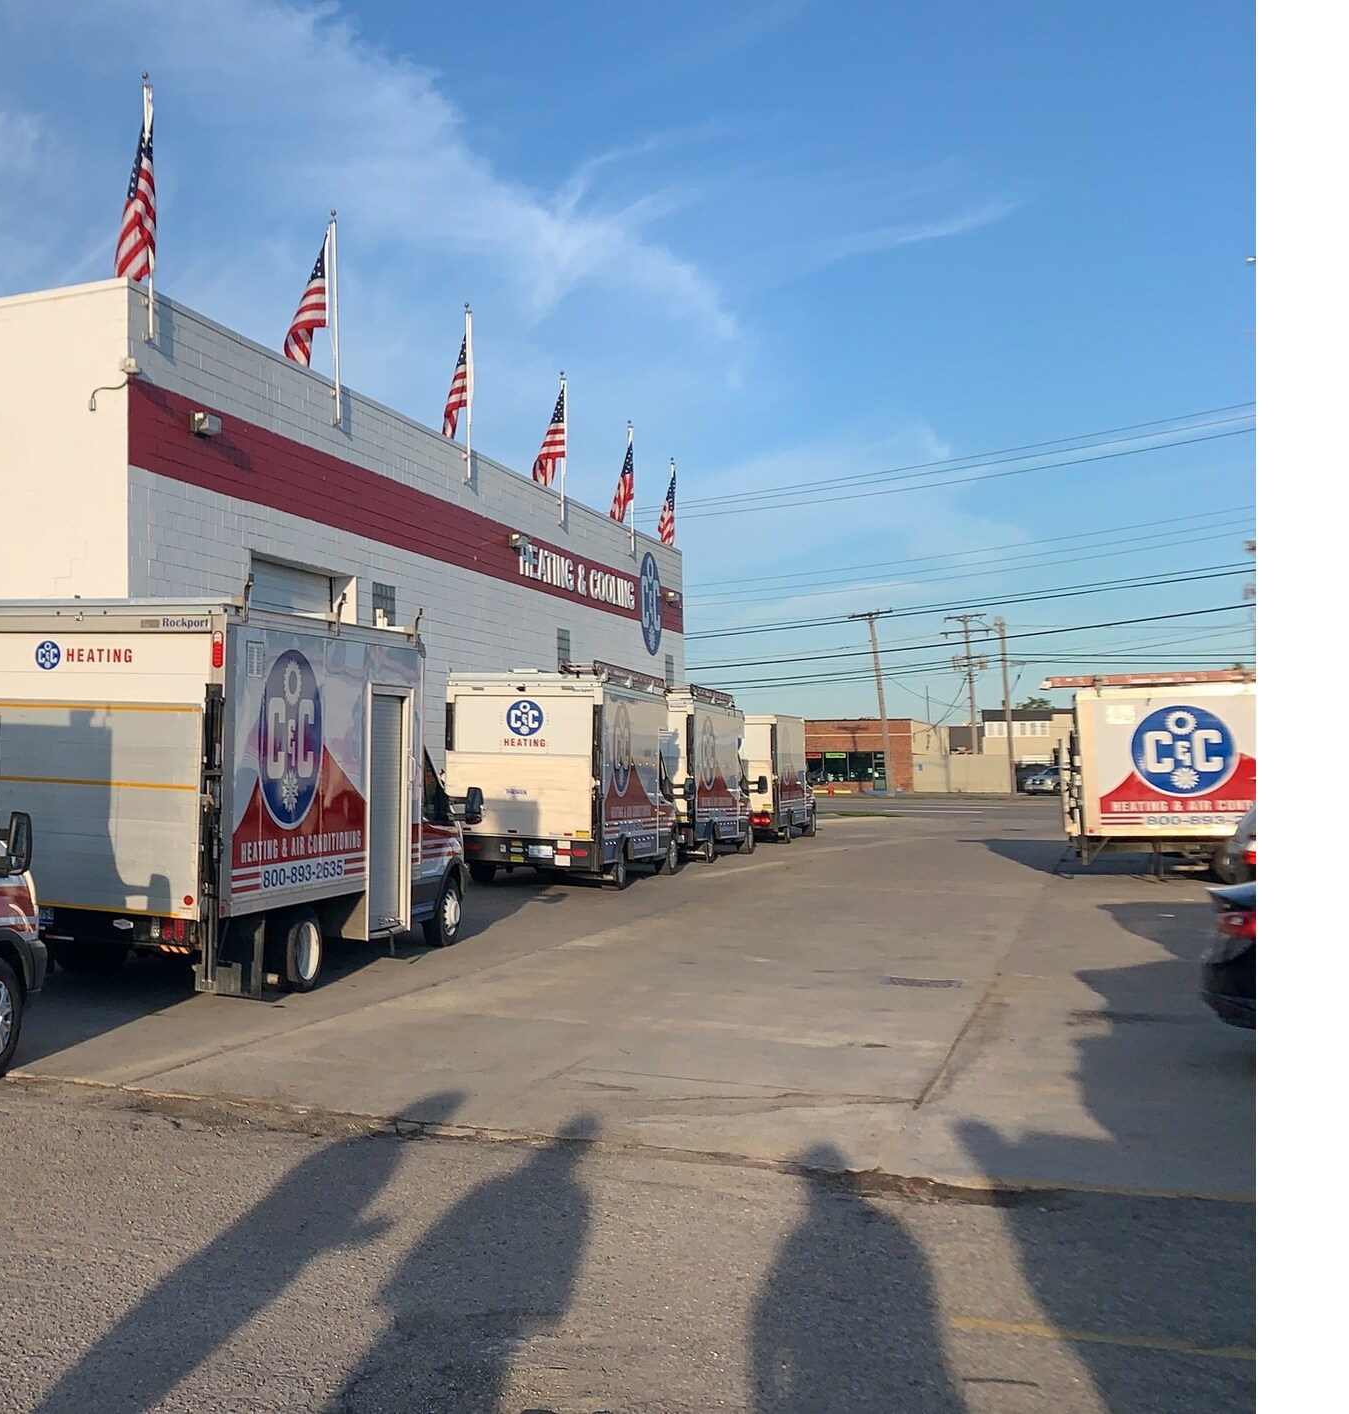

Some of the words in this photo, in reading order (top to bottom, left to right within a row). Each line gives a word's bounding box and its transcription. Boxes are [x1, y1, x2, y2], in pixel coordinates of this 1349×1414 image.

[519, 543, 575, 591] HEATING
[578, 564, 587, 596] &
[590, 569, 635, 610] COOLING
[162, 617, 209, 629] Rockport
[37, 648, 58, 663] C&C
[66, 648, 133, 663] HEATING
[511, 709, 539, 729] C&C
[267, 697, 314, 779] C&C
[504, 738, 546, 748] HEATING
[1144, 729, 1224, 773] C&C
[1111, 800, 1168, 812] HEATING
[1174, 801, 1183, 811] &
[1189, 801, 1212, 811] AIR
[241, 839, 278, 863] HEATING
[281, 838, 288, 858] &
[291, 836, 306, 857] AIR
[308, 830, 361, 854] CONDITIONING
[263, 860, 343, 888] 800-893-2635
